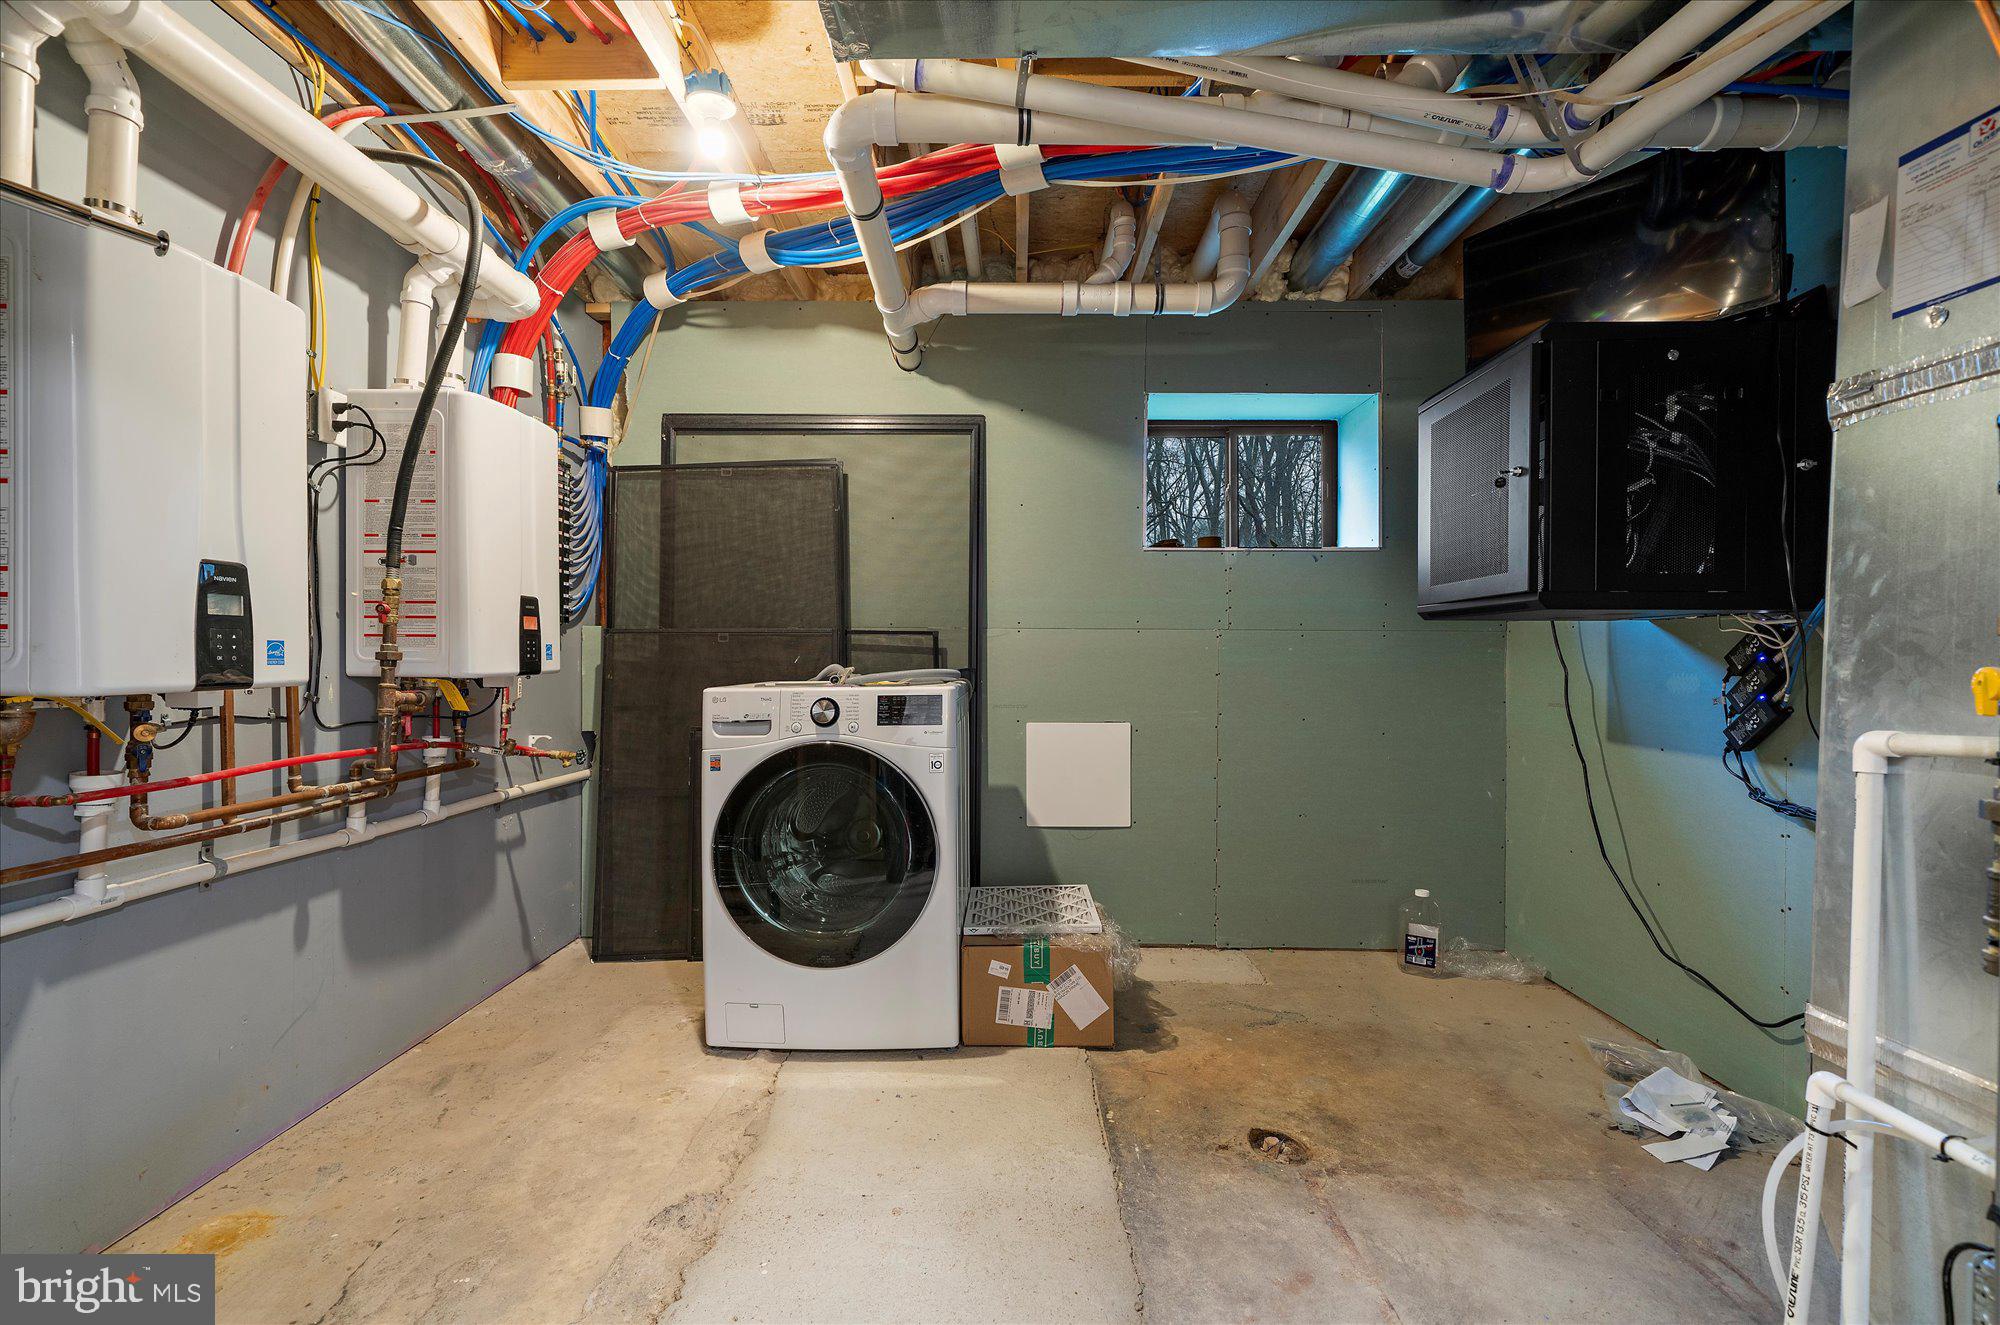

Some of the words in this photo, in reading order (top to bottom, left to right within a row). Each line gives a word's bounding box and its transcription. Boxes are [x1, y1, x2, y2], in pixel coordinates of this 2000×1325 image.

[1808, 1143, 1814, 1152] AT
[1801, 1174, 1811, 1192] PSI
[1799, 1192, 1809, 1208] 315
[1794, 1236, 1803, 1255] SDR
